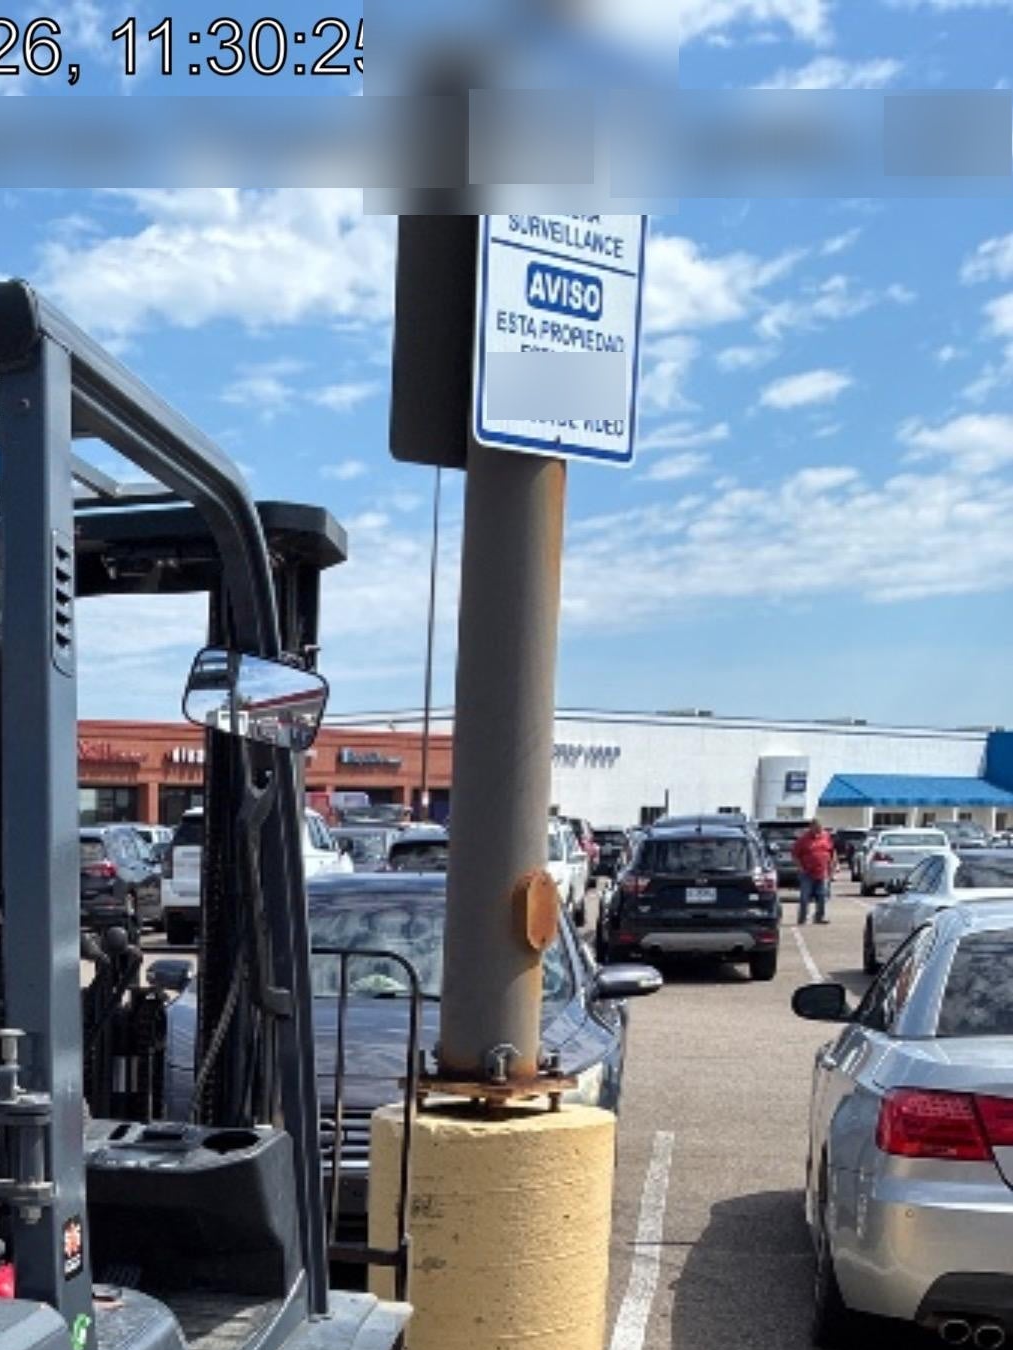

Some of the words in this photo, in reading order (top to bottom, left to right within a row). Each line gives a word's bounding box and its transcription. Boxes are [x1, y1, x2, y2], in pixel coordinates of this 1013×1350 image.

[508, 215, 625, 259] SURVEILLANCE
[529, 269, 602, 313] AVISO
[496, 309, 537, 340] ESTA
[539, 319, 625, 353] PROPIEDAD
